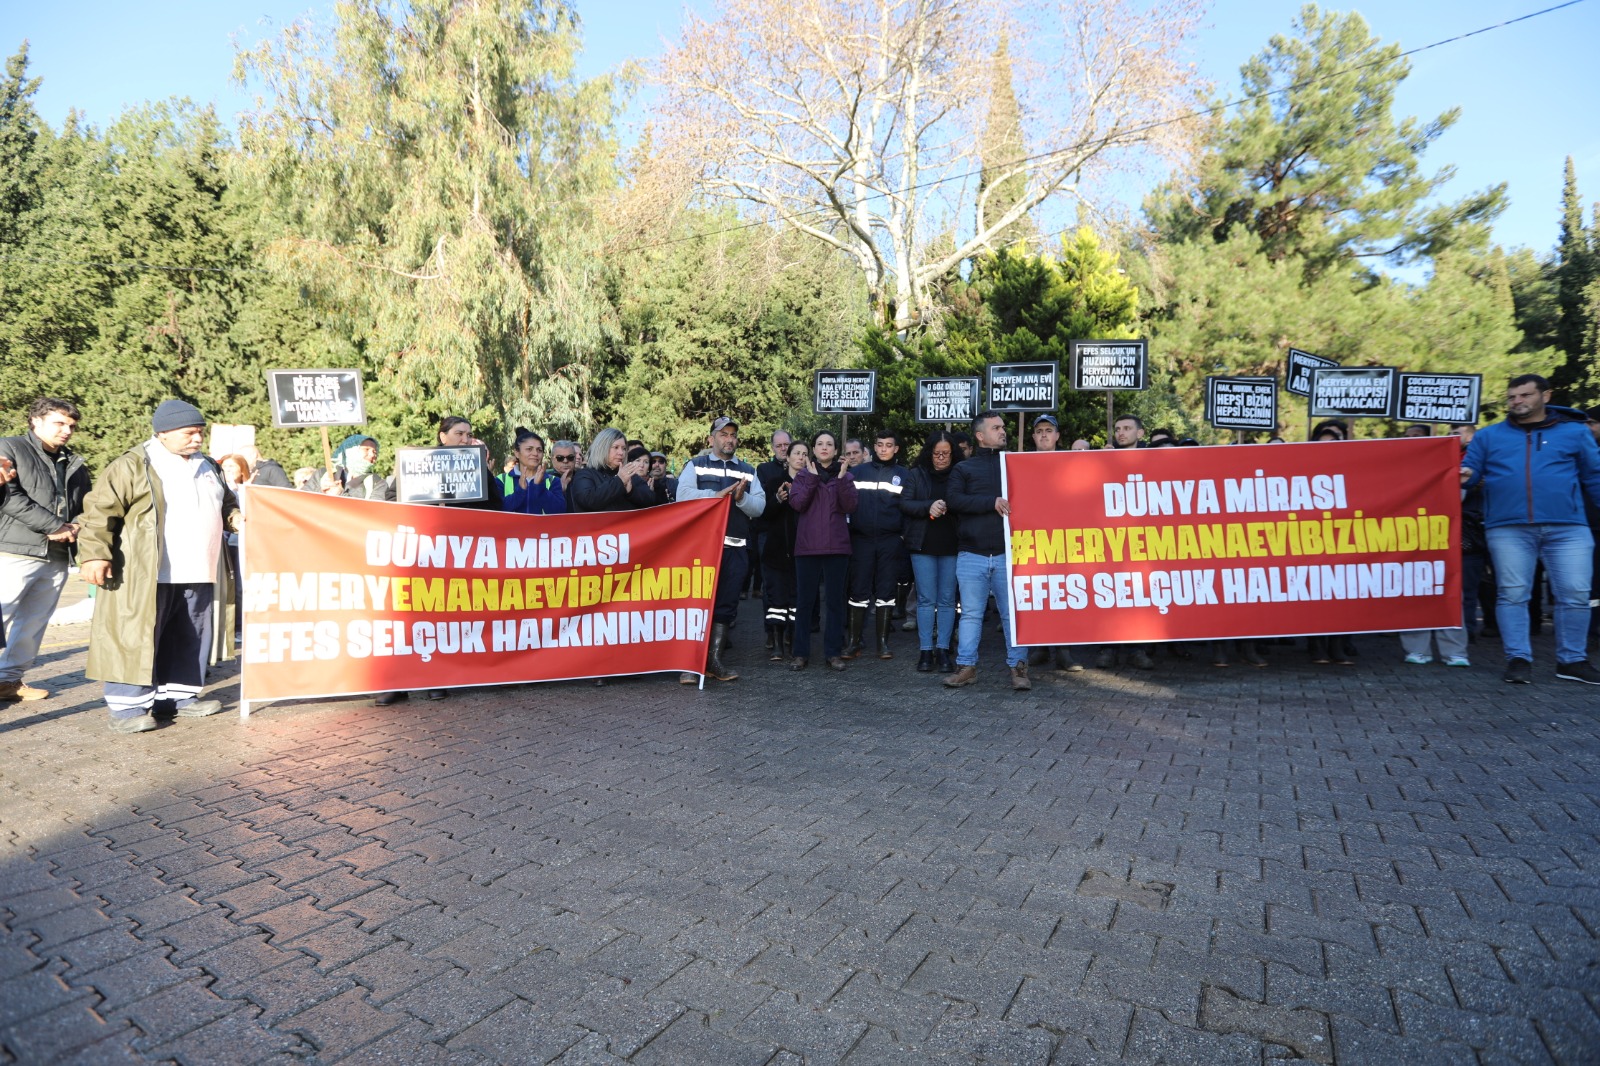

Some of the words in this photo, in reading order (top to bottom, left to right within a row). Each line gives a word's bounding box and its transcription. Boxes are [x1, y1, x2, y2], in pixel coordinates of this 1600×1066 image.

[1083, 347, 1098, 355] EFES
[1083, 356, 1116, 366] HUZURU
[1118, 355, 1136, 367] İÇİN
[1293, 354, 1321, 368] MERYEM
[1082, 367, 1110, 375] MERYEM
[1111, 367, 1135, 375] ANA'YA
[993, 375, 1021, 384] MERYEM
[1023, 375, 1039, 384] ANA
[1040, 372, 1052, 383] EVİ
[1082, 375, 1134, 387] DOKUNMA!
[1318, 378, 1352, 386] MERYEM
[1353, 378, 1372, 386] ANA
[1373, 376, 1388, 386] EVİ
[835, 383, 843, 391] EVİ
[844, 383, 869, 391] BİZİMDİR
[932, 382, 944, 390] GÖZ
[1217, 384, 1231, 392] HAK,
[1318, 386, 1347, 397] RANT
[1349, 386, 1387, 397] KAPISI
[1407, 385, 1448, 396] GELECEĞİ
[1449, 386, 1469, 397] İÇİN
[294, 386, 340, 401] MABET
[821, 390, 839, 399] EFES
[841, 390, 869, 400] SELÇUK
[992, 384, 1052, 401] BİZİMDİR!
[821, 399, 869, 408] HALKININDIR!
[1217, 392, 1244, 406] HEPSİ
[1246, 393, 1271, 407] BİZİM
[1317, 397, 1386, 408] OLMAYACAK!
[1406, 395, 1437, 403] MERYEM
[1454, 396, 1468, 405] EVİ
[926, 404, 970, 419] BIRAK!
[1216, 405, 1241, 416] HEPSİ
[1242, 405, 1271, 418] İŞÇİNİN
[1405, 403, 1466, 420] BİZİMDİR
[406, 460, 450, 473] MERYEM
[453, 460, 475, 471] ANA
[445, 472, 477, 484] HAKKI
[432, 483, 477, 494] SELÇUK'A
[1103, 474, 1220, 517] DÜNYA
[1224, 469, 1347, 513] MİRASI
[1010, 508, 1449, 565] #MERYEMANAEVİBİZİMDİR
[365, 525, 498, 568] DÜNYA
[506, 533, 629, 568] MİRASI
[243, 559, 715, 612] #MERYEMANAEVİBİZİMDİR
[1014, 573, 1088, 611] EFES
[1092, 569, 1218, 614] SELÇUK
[1221, 560, 1445, 604] HALKININDIR!
[246, 621, 340, 664] EFES
[347, 620, 486, 662] SELÇUK
[492, 608, 708, 652] HALKININDIR!
